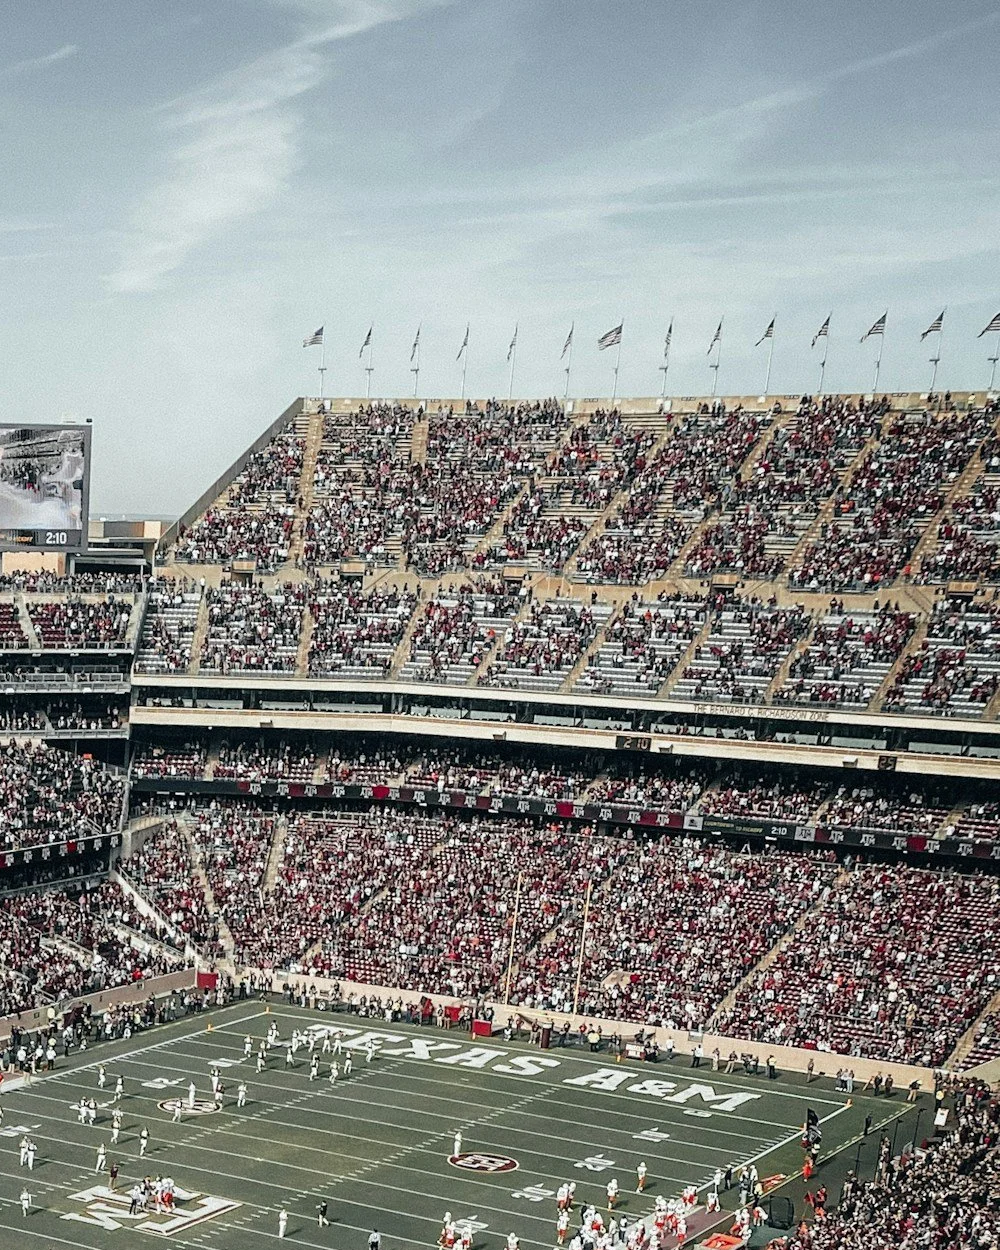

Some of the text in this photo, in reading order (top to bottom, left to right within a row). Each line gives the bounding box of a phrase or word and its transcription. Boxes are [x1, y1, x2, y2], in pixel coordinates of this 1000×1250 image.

[45, 531, 68, 545] 2:10
[771, 826, 788, 836] 2:10
[270, 1023, 762, 1112] TEXAS A&M
